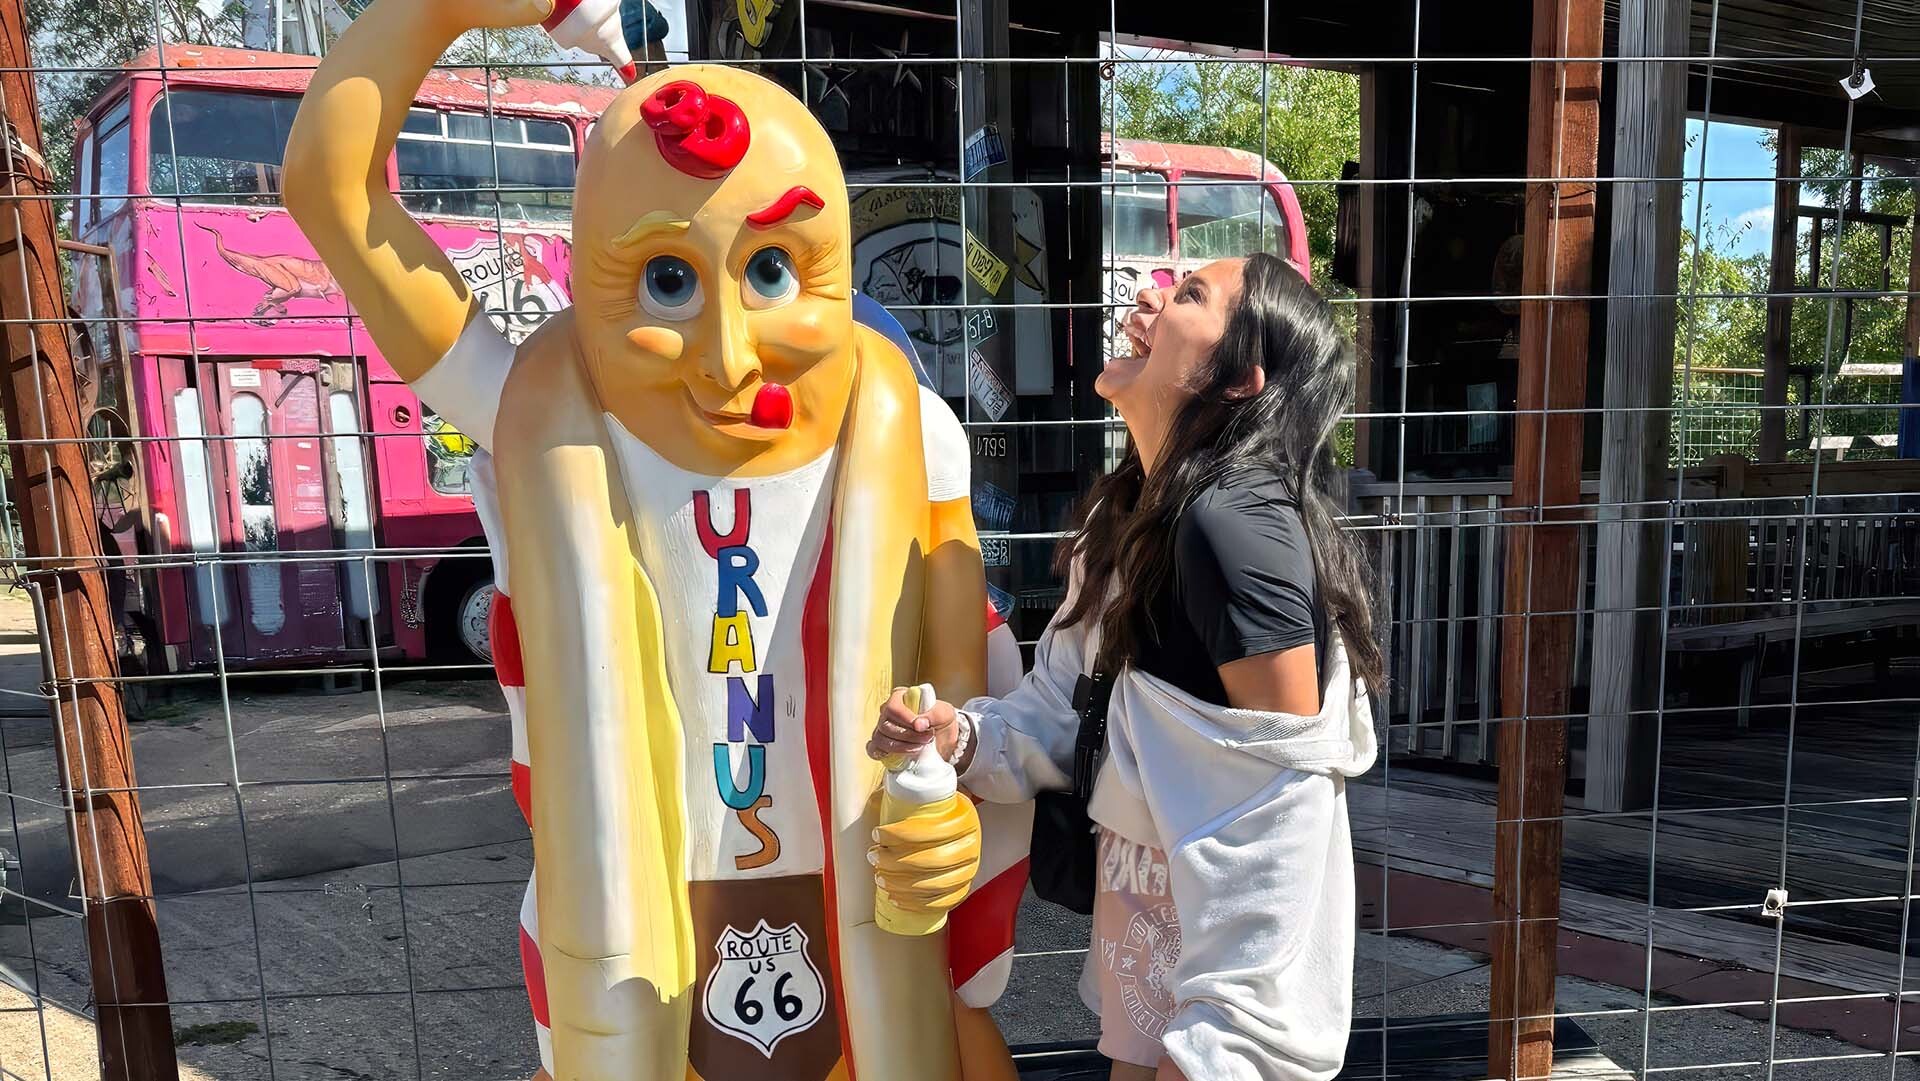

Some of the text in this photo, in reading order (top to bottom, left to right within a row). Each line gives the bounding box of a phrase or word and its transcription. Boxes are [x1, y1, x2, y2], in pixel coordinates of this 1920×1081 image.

[692, 487, 782, 870] URANUS
[727, 934, 793, 958] ROUTE
[749, 957, 776, 975] US
[734, 971, 803, 1025] 66
